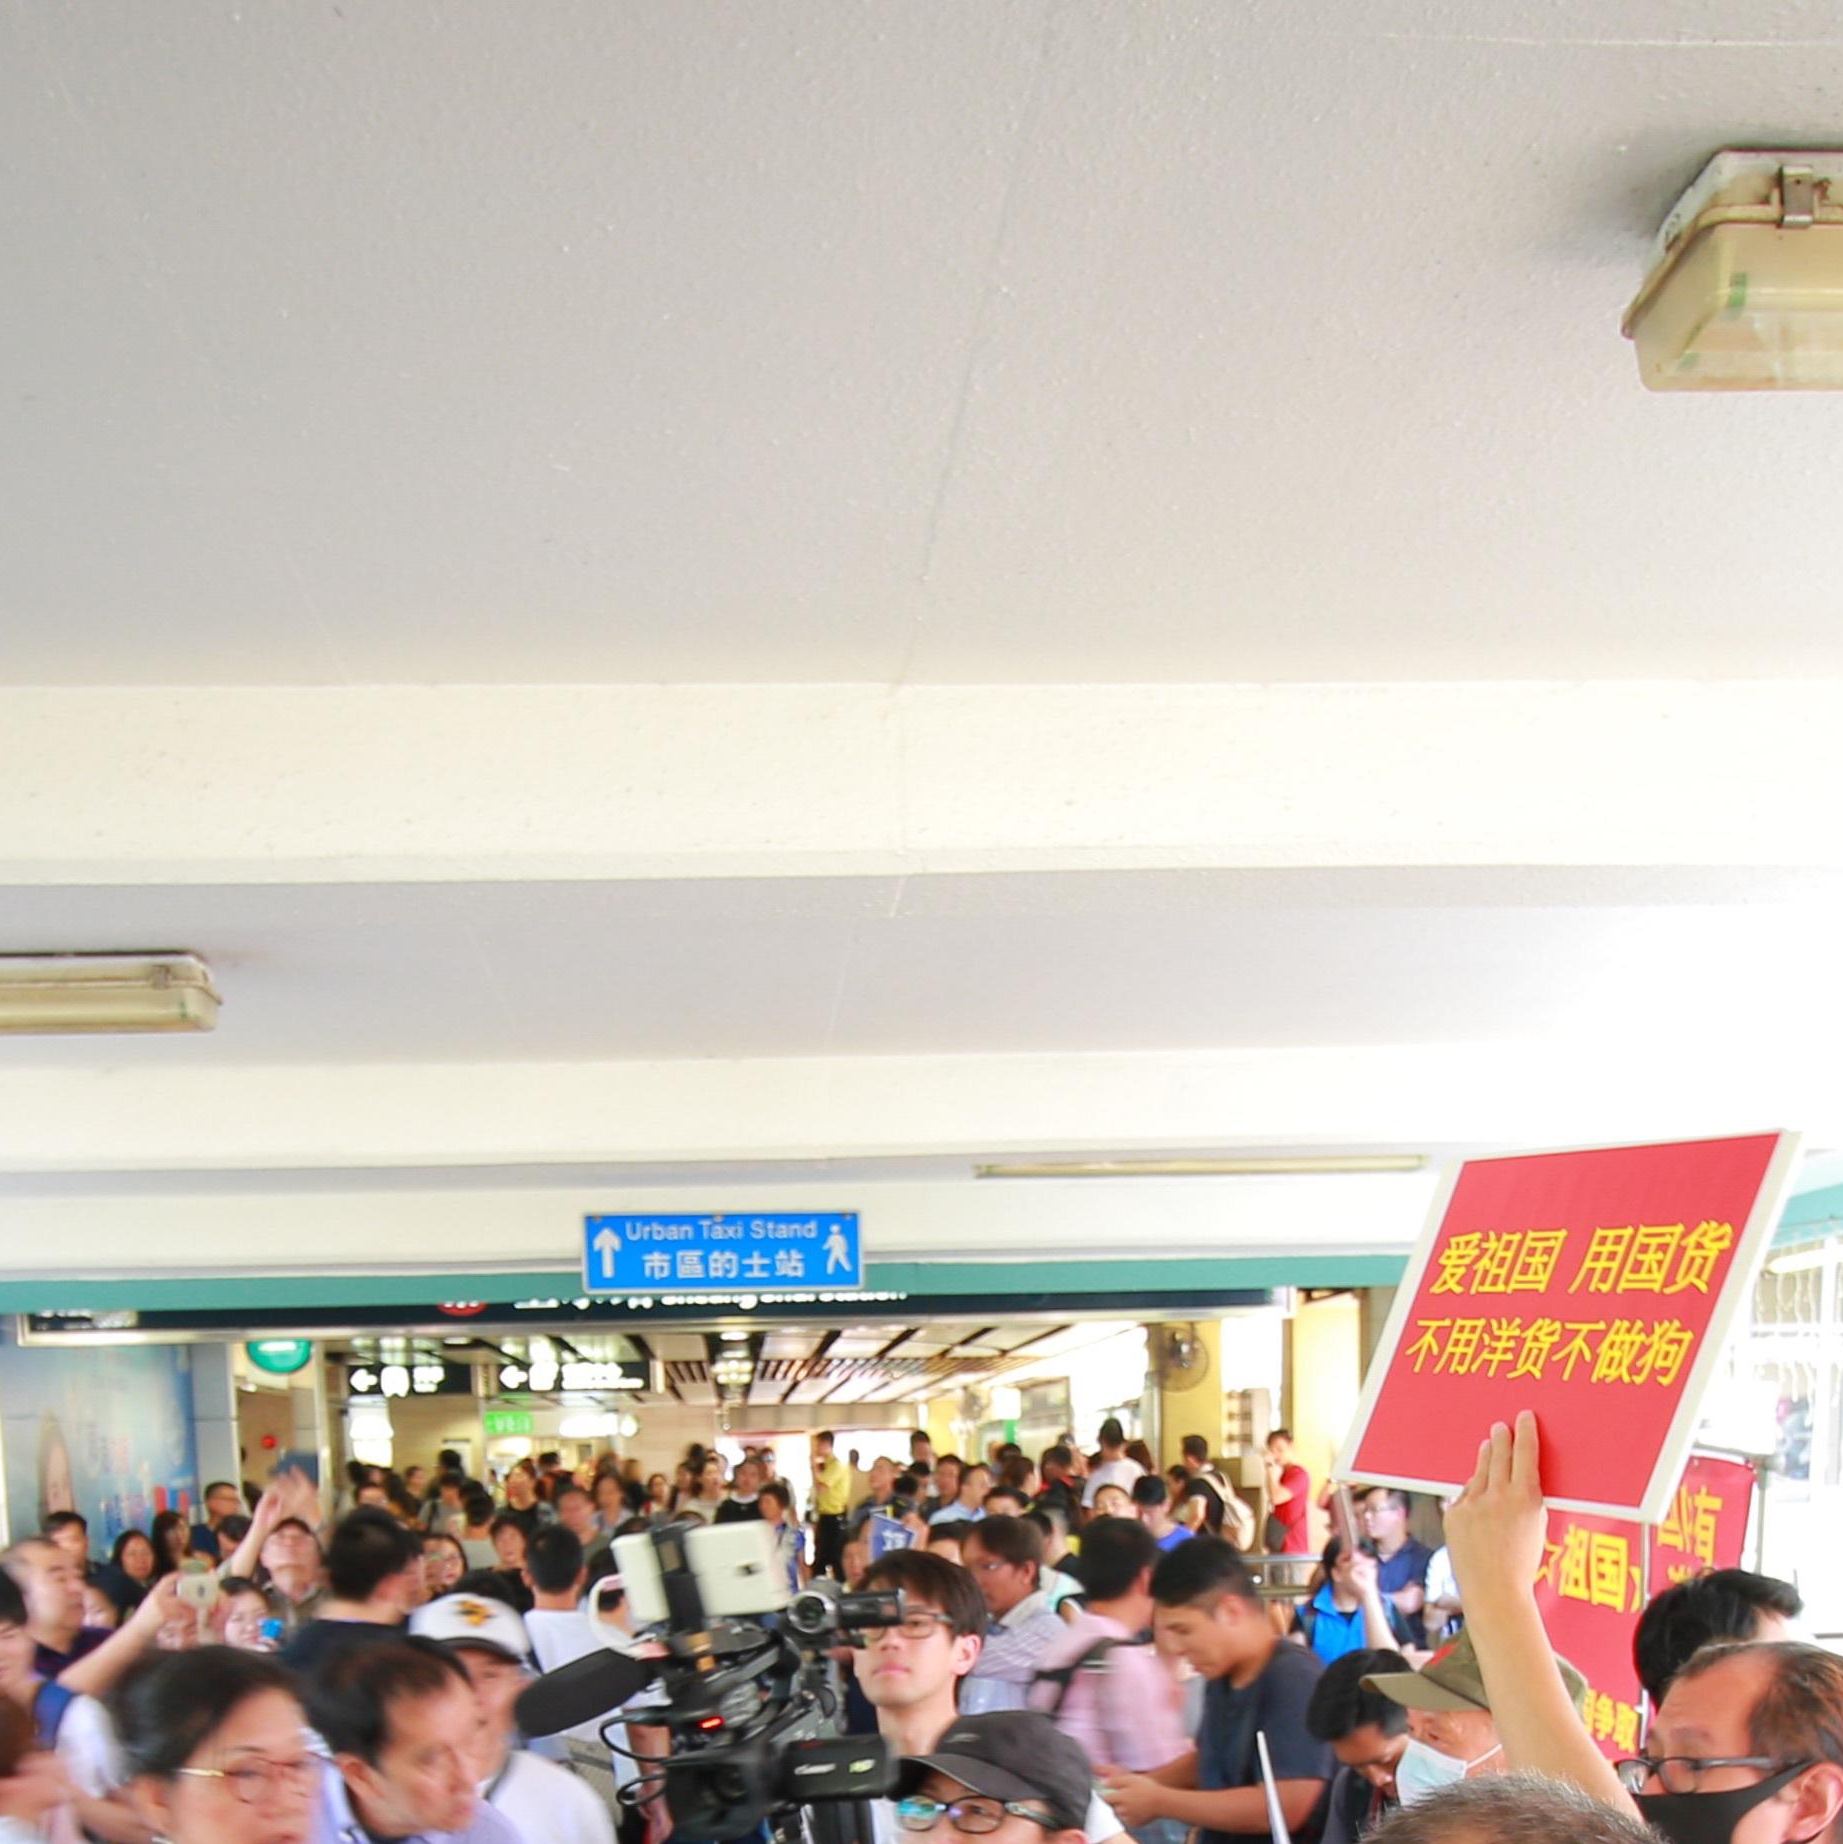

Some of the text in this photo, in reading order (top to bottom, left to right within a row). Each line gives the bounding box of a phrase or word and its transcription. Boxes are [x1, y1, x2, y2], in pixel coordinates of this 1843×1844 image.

[625, 1219, 818, 1241] Urban Taxi Stand
[641, 1249, 806, 1279] 市區的士站
[1429, 1220, 1733, 1295] 爱祖国 用国货
[1405, 1316, 1695, 1387] 不用洋货不做狗
